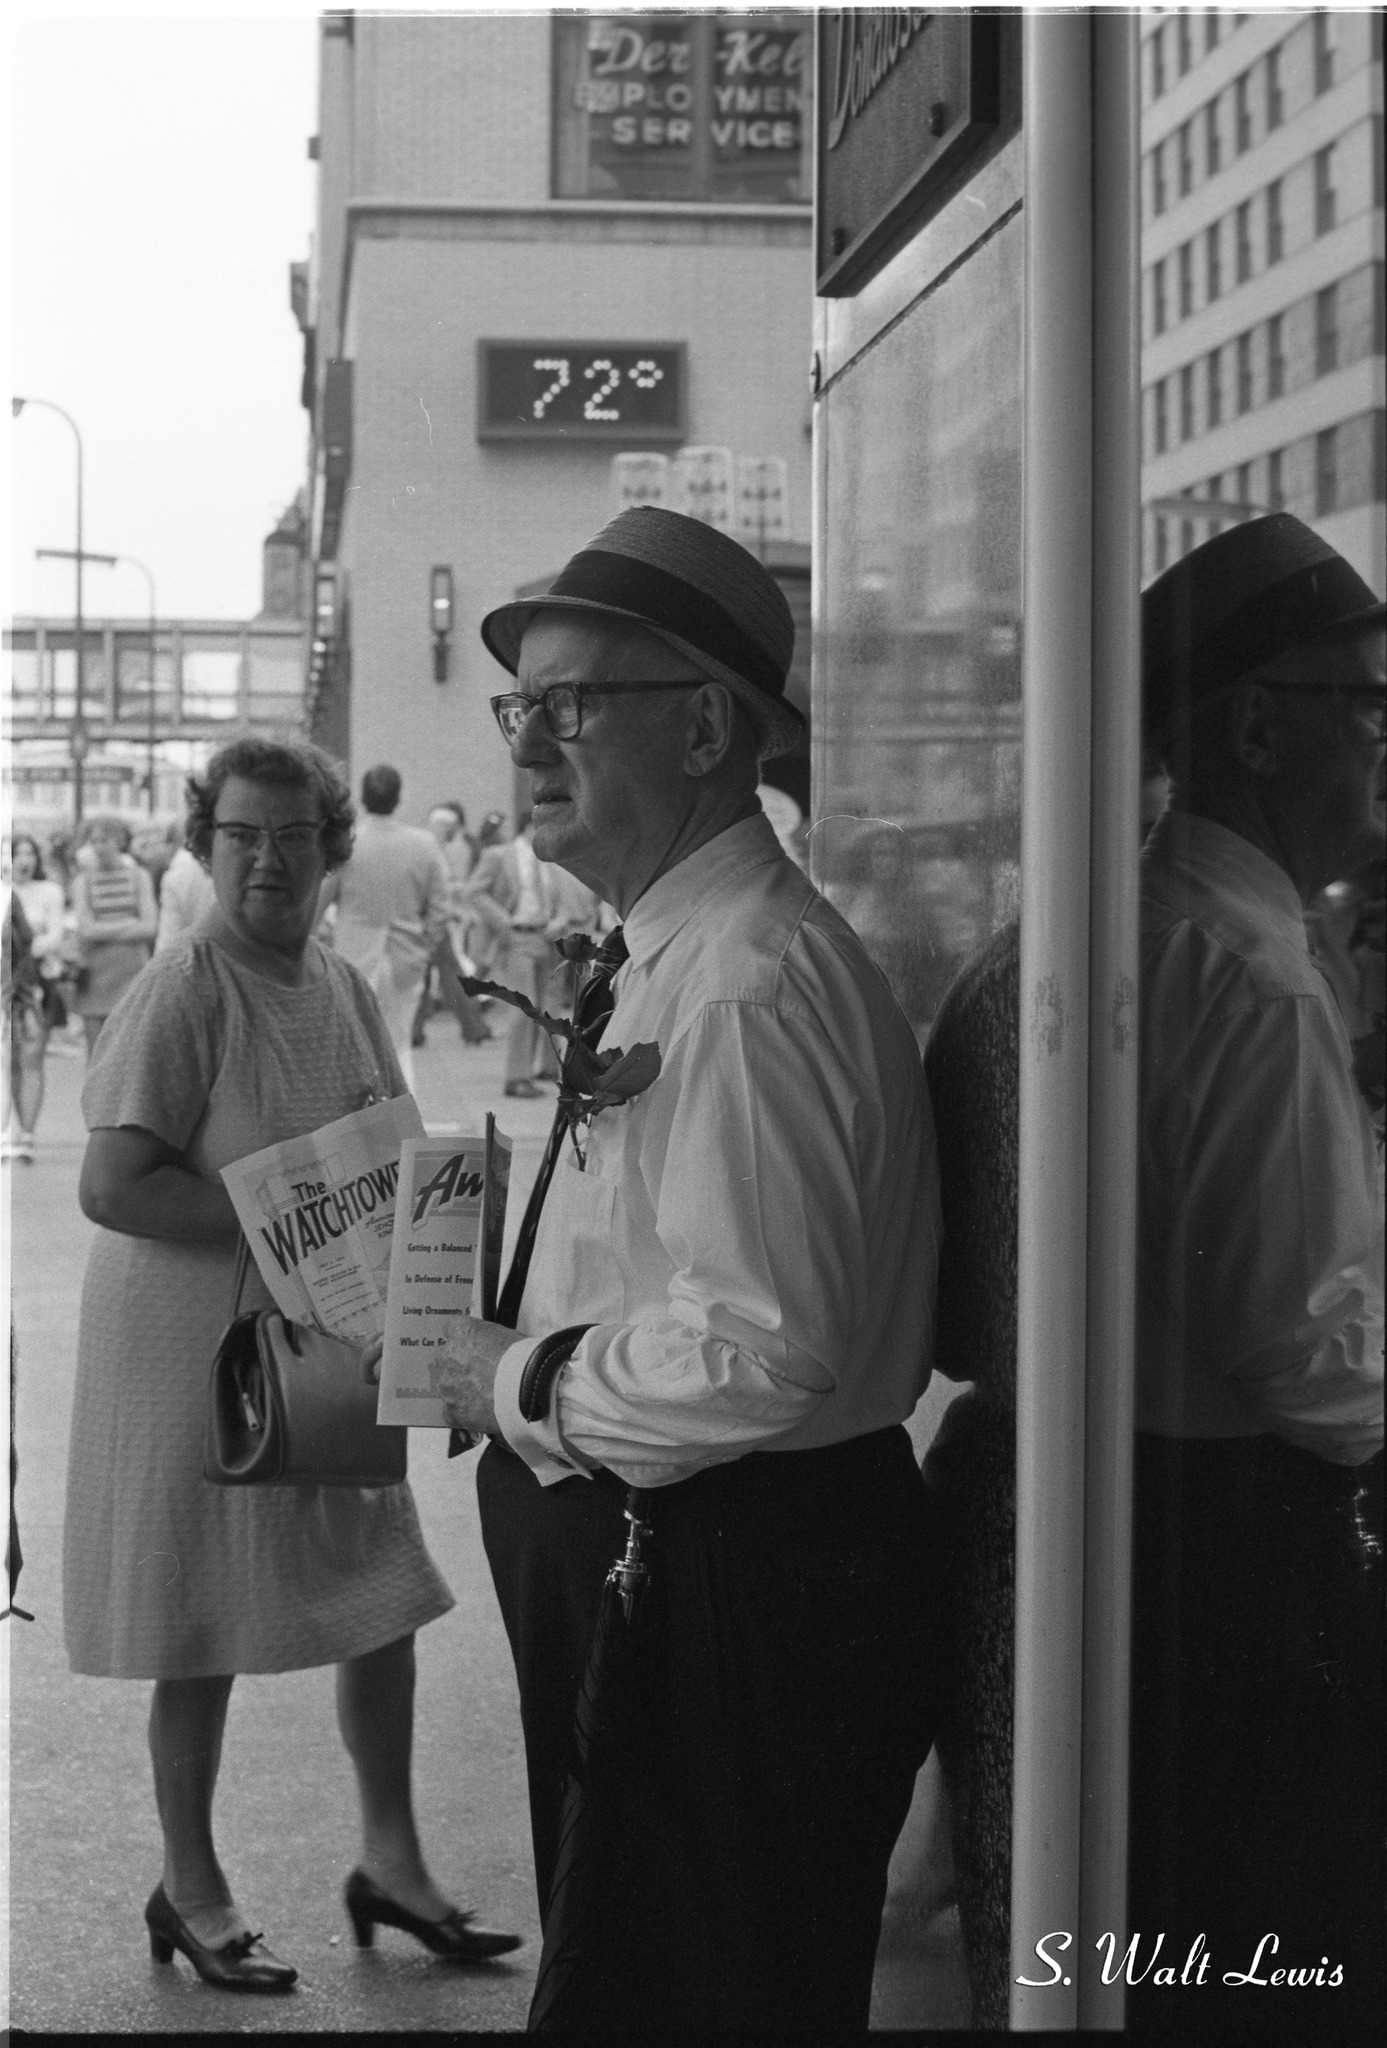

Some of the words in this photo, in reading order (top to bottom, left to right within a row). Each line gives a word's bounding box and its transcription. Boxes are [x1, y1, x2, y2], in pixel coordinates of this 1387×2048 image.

[290, 1181, 327, 1202] The
[407, 1243, 431, 1253] Getting
[441, 1242, 473, 1253] Balanced
[405, 1274, 412, 1284] In
[414, 1274, 442, 1284] Defense
[444, 1274, 453, 1284] of
[402, 1306, 422, 1317] Living
[425, 1305, 462, 1315] Ornaments
[400, 1337, 419, 1347] What
[421, 1337, 435, 1347] Can
